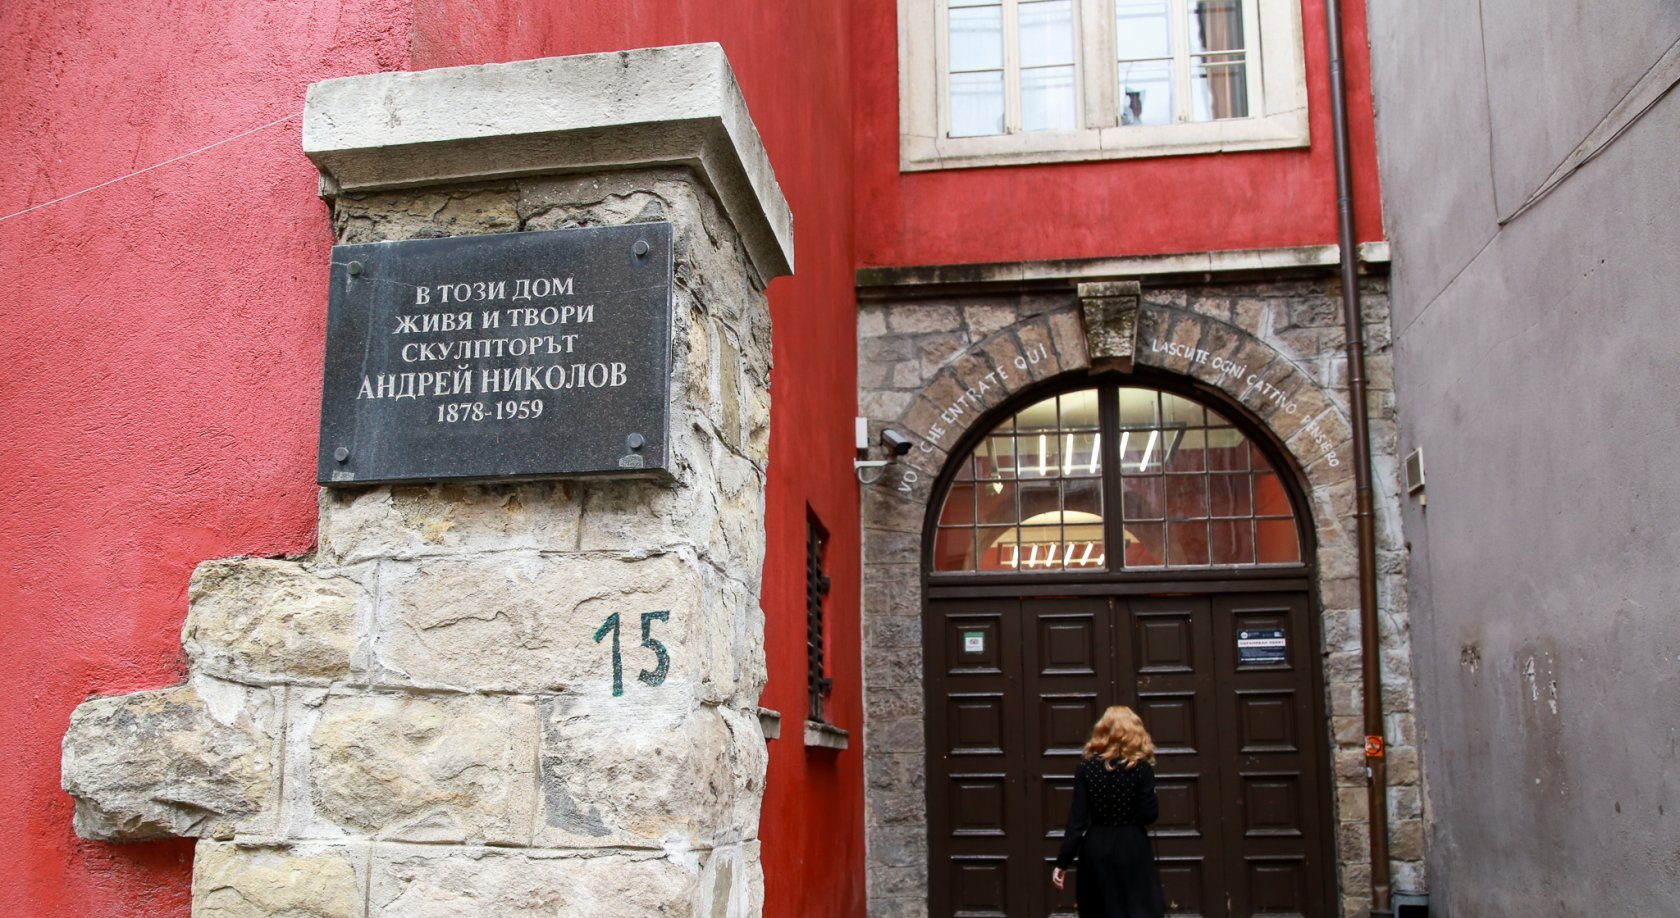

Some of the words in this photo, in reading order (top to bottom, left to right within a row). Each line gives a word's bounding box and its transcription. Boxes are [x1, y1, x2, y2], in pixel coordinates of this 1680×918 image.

[415, 286, 430, 305] В
[437, 280, 506, 303] ТОЗИ
[511, 277, 575, 302] ДОМ
[393, 312, 473, 334] ЖИВЯ
[482, 311, 500, 329] И
[507, 304, 595, 327] ТВОРИ
[401, 334, 579, 362] СКУЛПТОРЪТ
[356, 365, 473, 400] АНДРЕЙ
[481, 362, 628, 393] НИКОЛОВ
[438, 400, 544, 423] 1878-1959
[920, 423, 946, 454] CHE
[941, 365, 1008, 423] ENTRATE
[1014, 343, 1048, 369] QUI
[592, 610, 670, 697] 15
